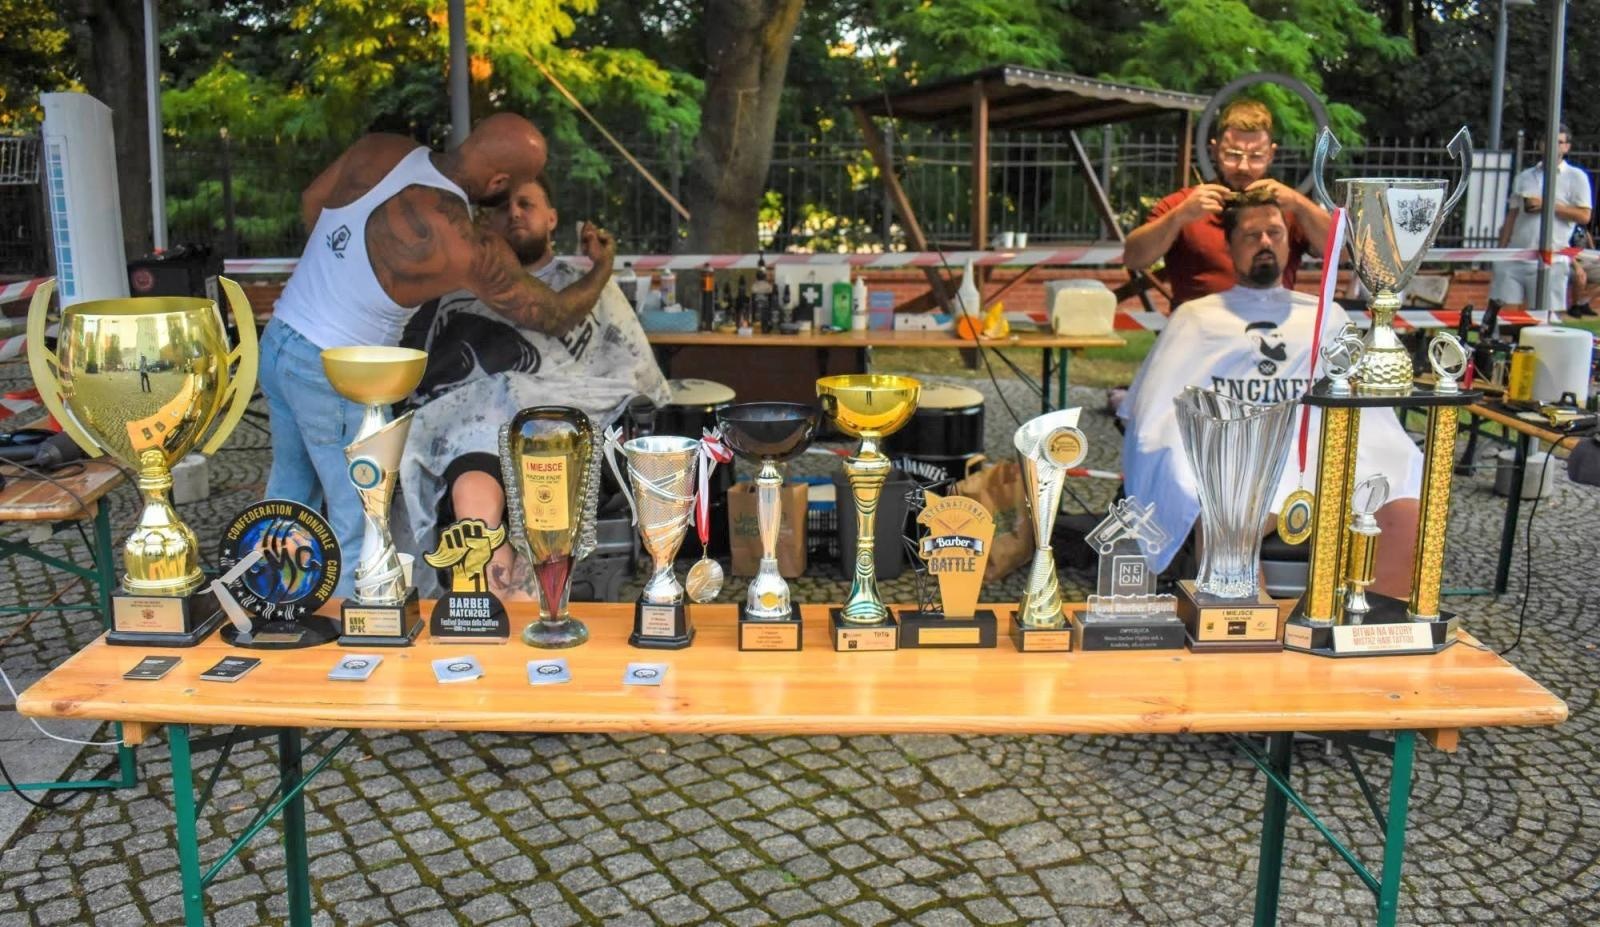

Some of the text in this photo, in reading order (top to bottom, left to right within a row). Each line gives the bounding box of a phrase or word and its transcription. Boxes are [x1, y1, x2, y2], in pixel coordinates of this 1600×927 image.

[530, 462, 563, 472] MIEJSCE
[937, 536, 971, 547] Barber
[227, 504, 338, 602] CONFEDERATION MONDIALE COIFFURE
[931, 557, 976, 572] BATTLE
[449, 598, 490, 608] BARBER
[1352, 625, 1413, 637] BITWA NA WZORY
